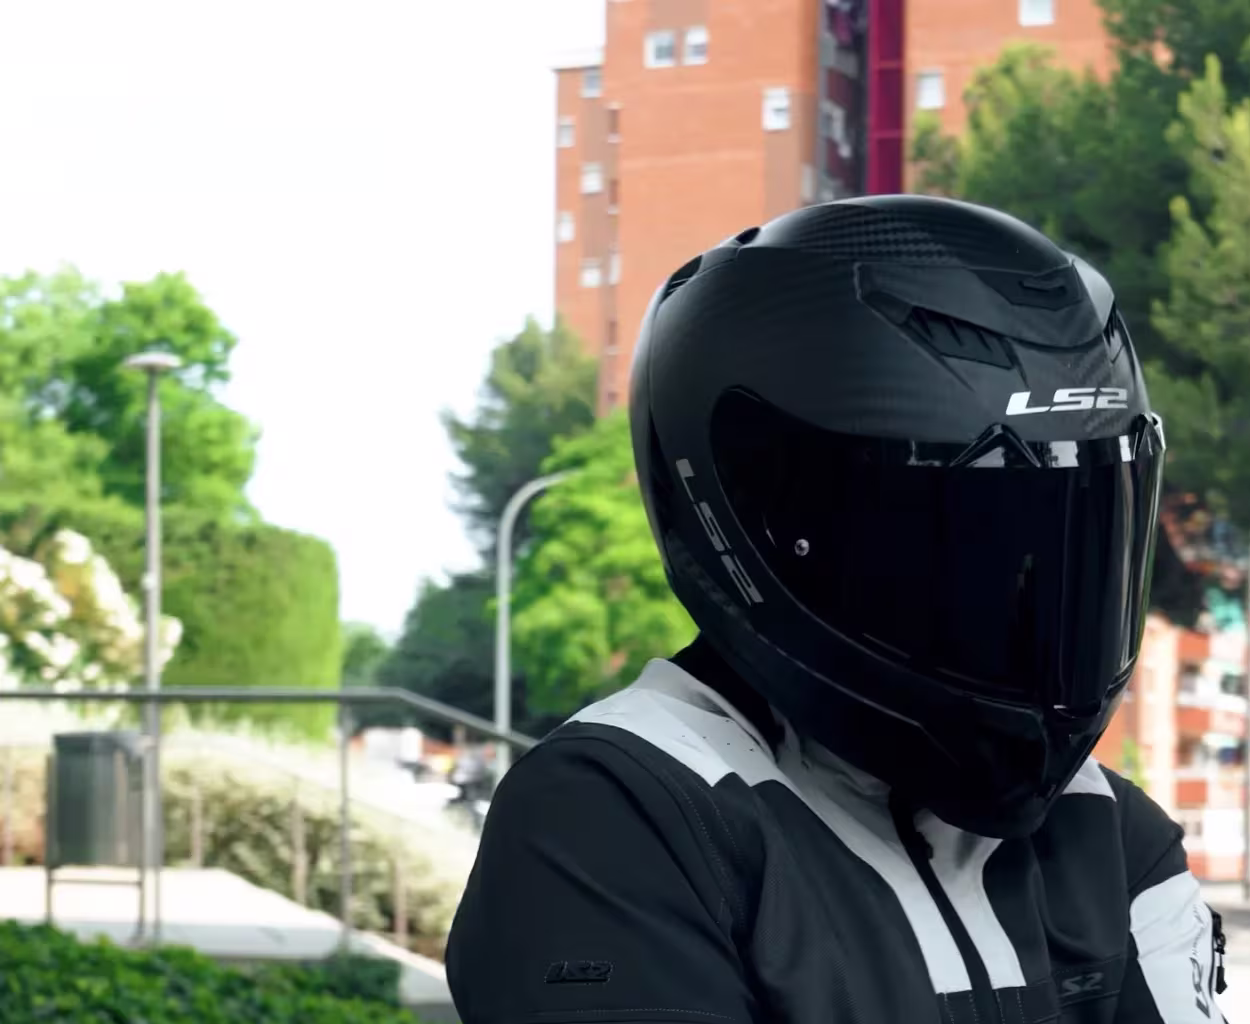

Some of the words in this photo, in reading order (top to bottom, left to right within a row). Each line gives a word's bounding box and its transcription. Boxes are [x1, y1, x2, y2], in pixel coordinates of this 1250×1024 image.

[1006, 387, 1128, 415] LS2
[676, 458, 765, 606] LS2
[1056, 972, 1103, 998] S2
